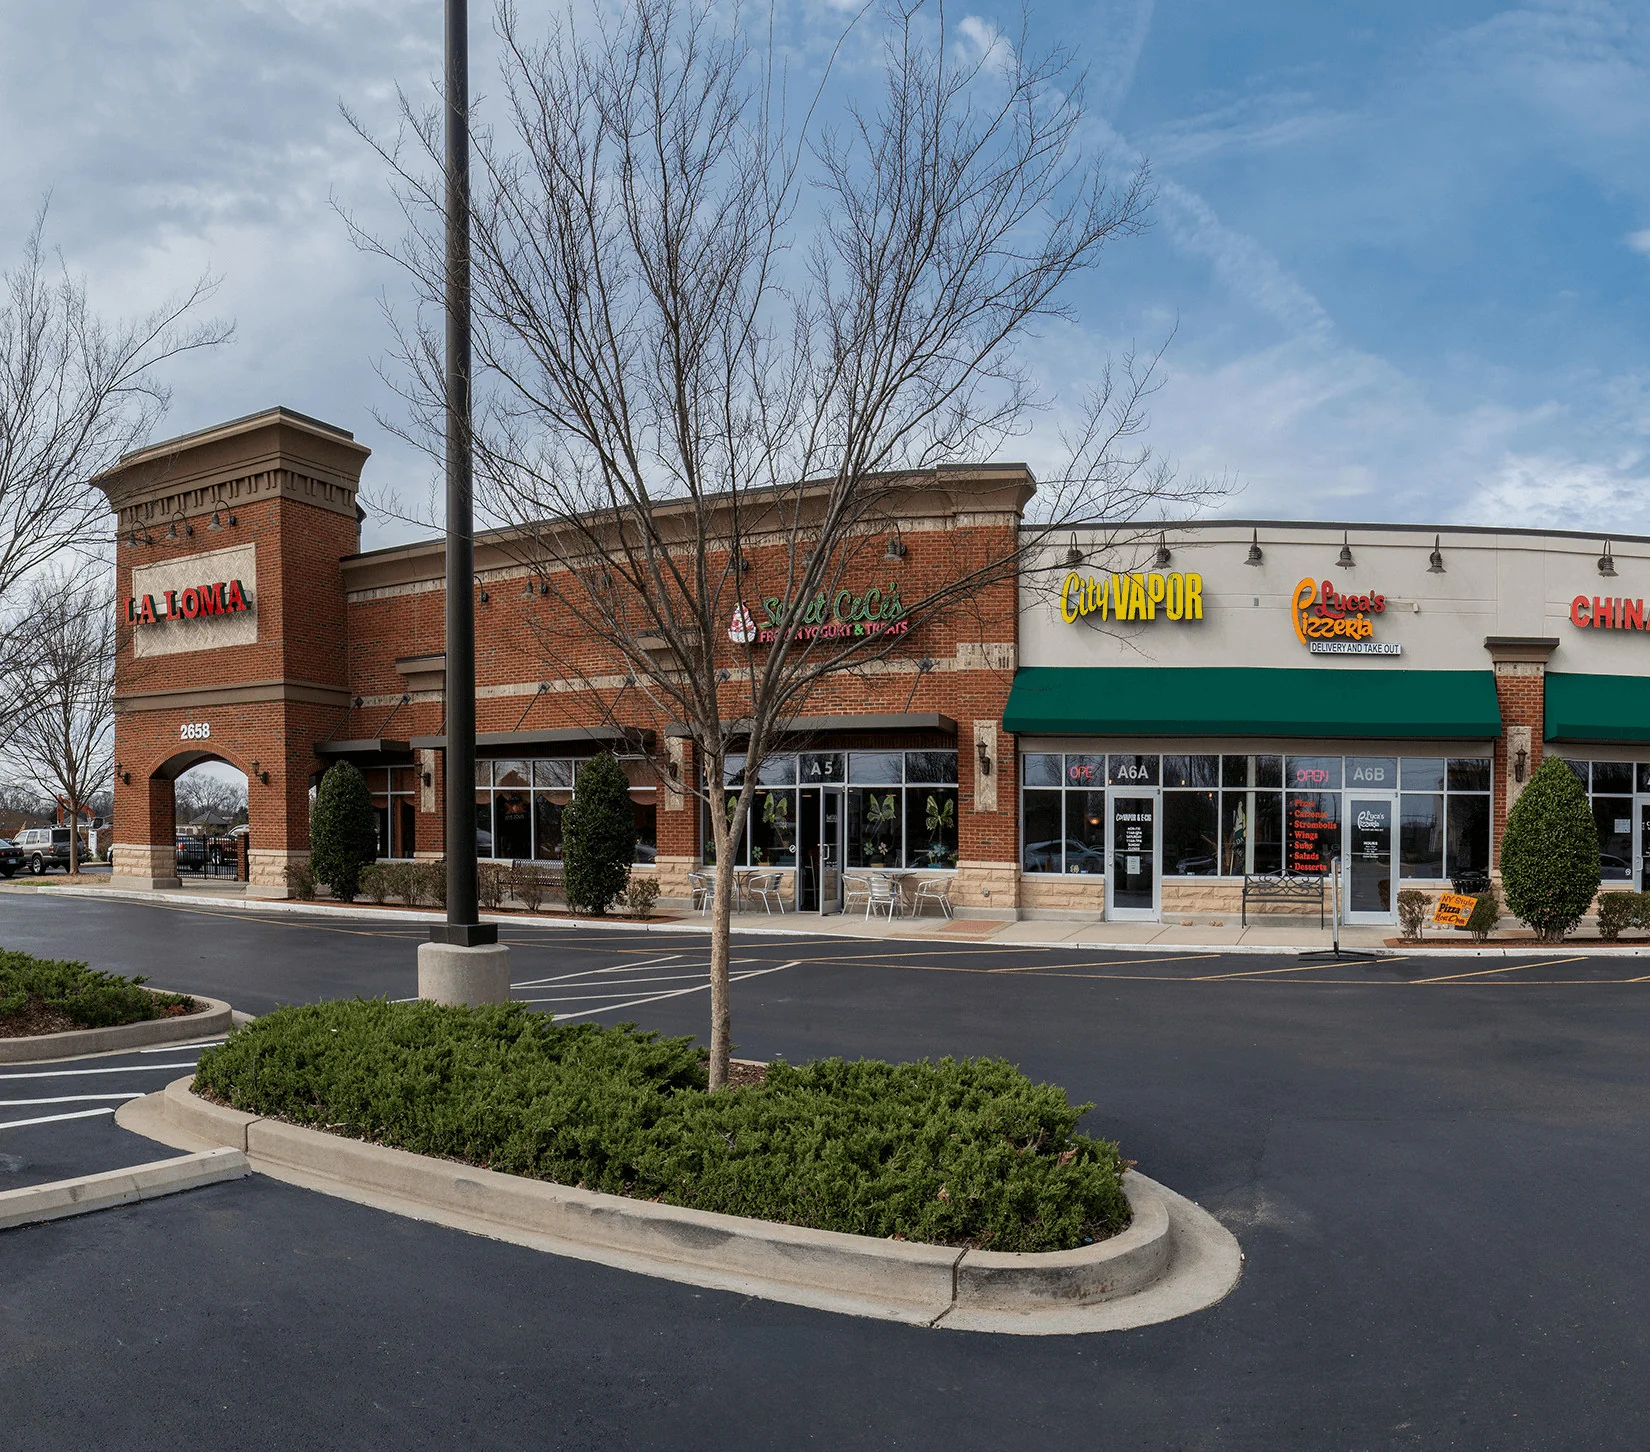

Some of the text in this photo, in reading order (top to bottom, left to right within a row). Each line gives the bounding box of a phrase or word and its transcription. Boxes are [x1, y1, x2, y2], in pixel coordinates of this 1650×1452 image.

[123, 579, 248, 625] LA LOMA
[1060, 571, 1203, 624] City VAPOR
[1314, 580, 1386, 619] Luca's
[760, 592, 827, 629] Set
[1291, 577, 1374, 645] Pizzeria
[854, 623, 864, 636] &
[865, 621, 909, 636] TRATS
[1311, 643, 1399, 653] DELIVERY AND TAKE OUT
[180, 722, 210, 740] 2658
[1117, 764, 1149, 779] A6A
[1296, 769, 1329, 782] OPEN
[1353, 767, 1385, 781] A6B
[1294, 820, 1337, 829] Strombolis
[1294, 830, 1318, 840] Wings
[1294, 841, 1313, 850] Subs
[1294, 852, 1319, 860] Salads
[1294, 862, 1327, 871] Desserts
[1442, 895, 1475, 907] NY Style
[1438, 903, 1461, 915] Pizza
